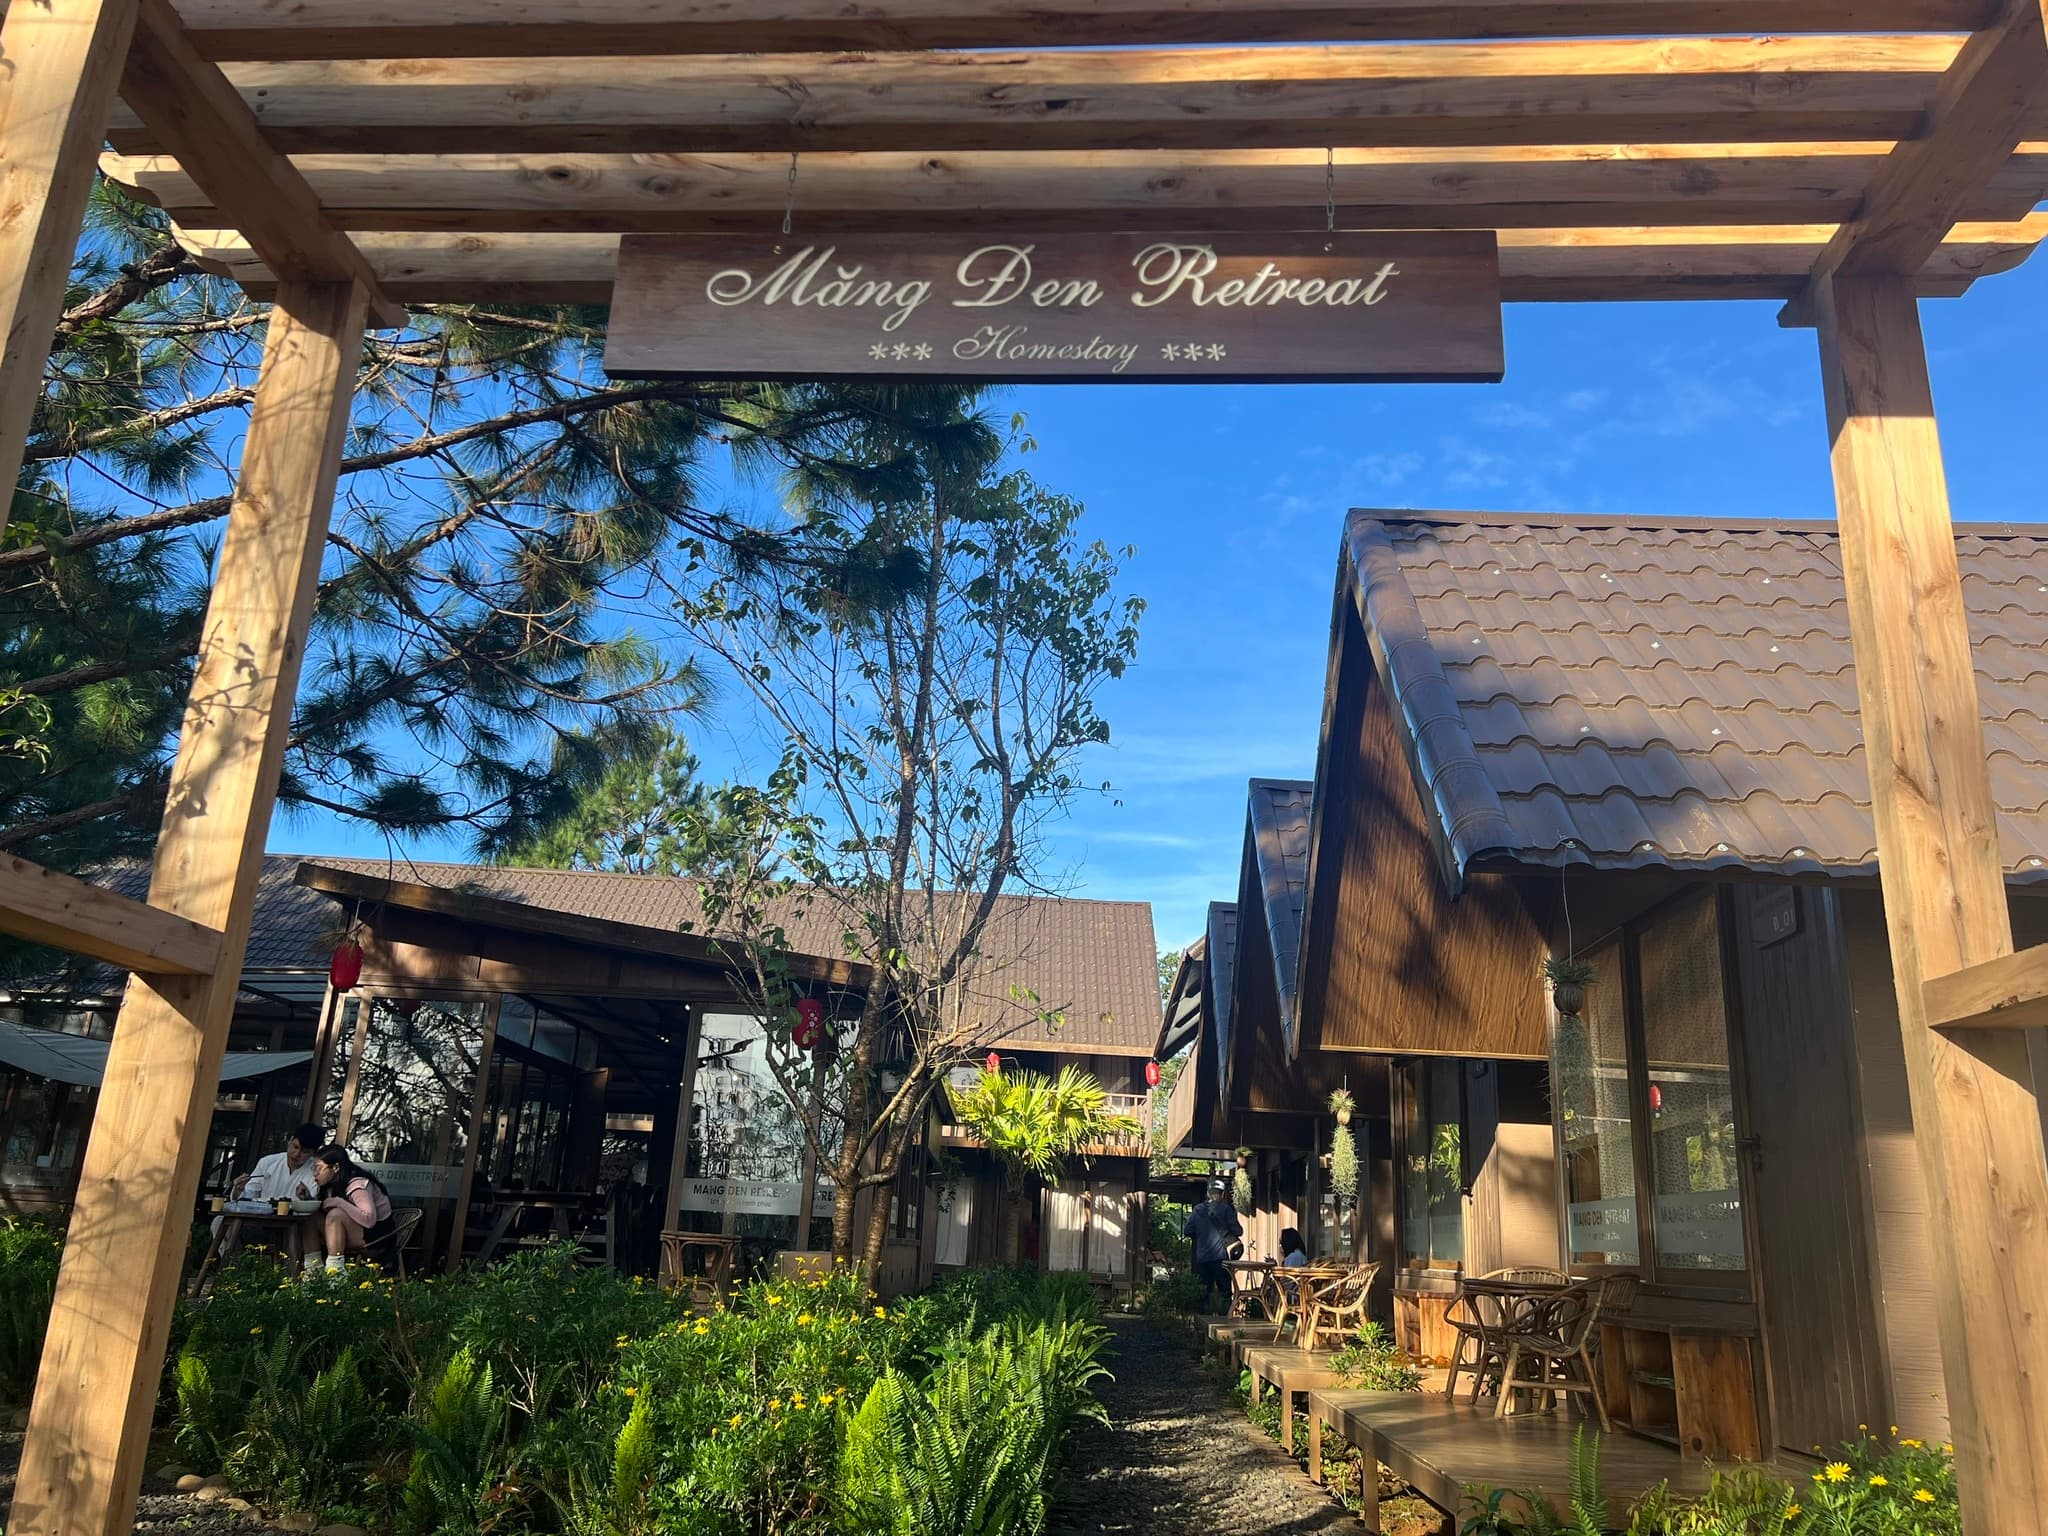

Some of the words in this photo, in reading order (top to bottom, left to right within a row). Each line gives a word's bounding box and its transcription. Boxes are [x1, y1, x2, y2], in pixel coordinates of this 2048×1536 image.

[707, 246, 932, 332] Măng
[952, 245, 1103, 307] Đen
[1131, 243, 1400, 307] Retreat
[953, 325, 1138, 374] Homestay
[693, 1184, 725, 1197] MANG
